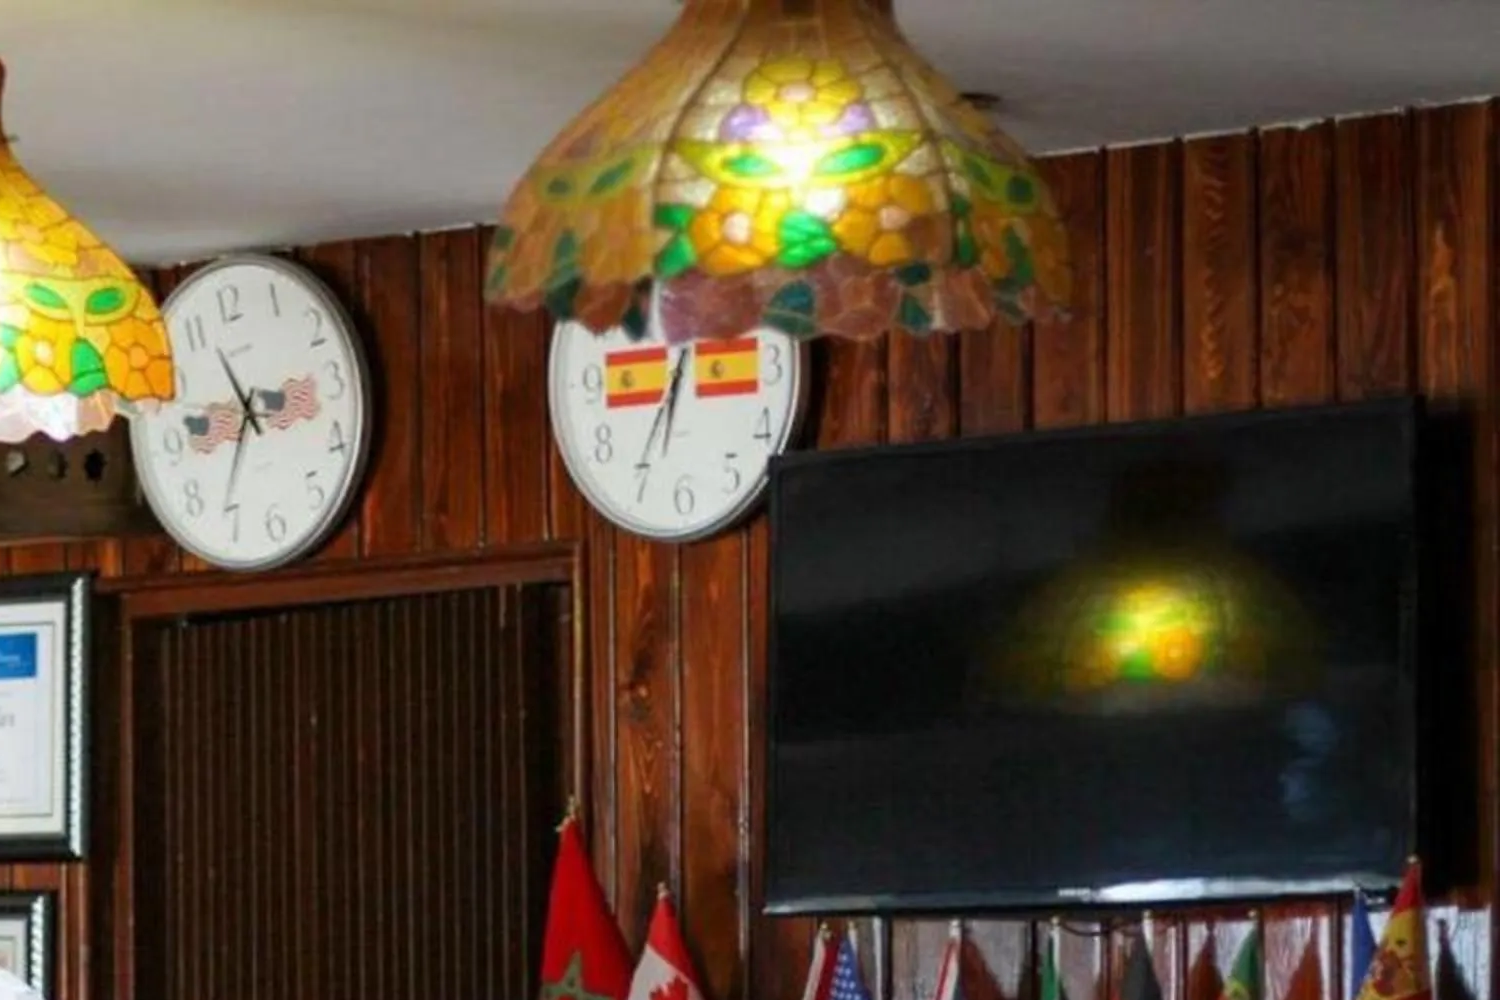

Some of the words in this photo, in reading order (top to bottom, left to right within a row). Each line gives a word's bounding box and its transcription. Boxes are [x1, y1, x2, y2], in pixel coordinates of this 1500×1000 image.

[217, 285, 243, 322] 12
[269, 283, 280, 317] 1
[185, 315, 207, 352] 11
[305, 310, 327, 348] 2
[323, 361, 345, 399] 3
[582, 363, 603, 403] 9
[762, 343, 783, 385] 3
[329, 420, 348, 455] 4
[595, 421, 613, 463] 8
[753, 406, 772, 445] 4
[163, 427, 183, 466] 9
[305, 470, 325, 510] 5
[634, 463, 651, 503] 7
[721, 452, 740, 493] 5
[183, 480, 204, 517] 8
[674, 473, 694, 515] 6
[224, 504, 240, 543] 7
[265, 504, 286, 544] 6
